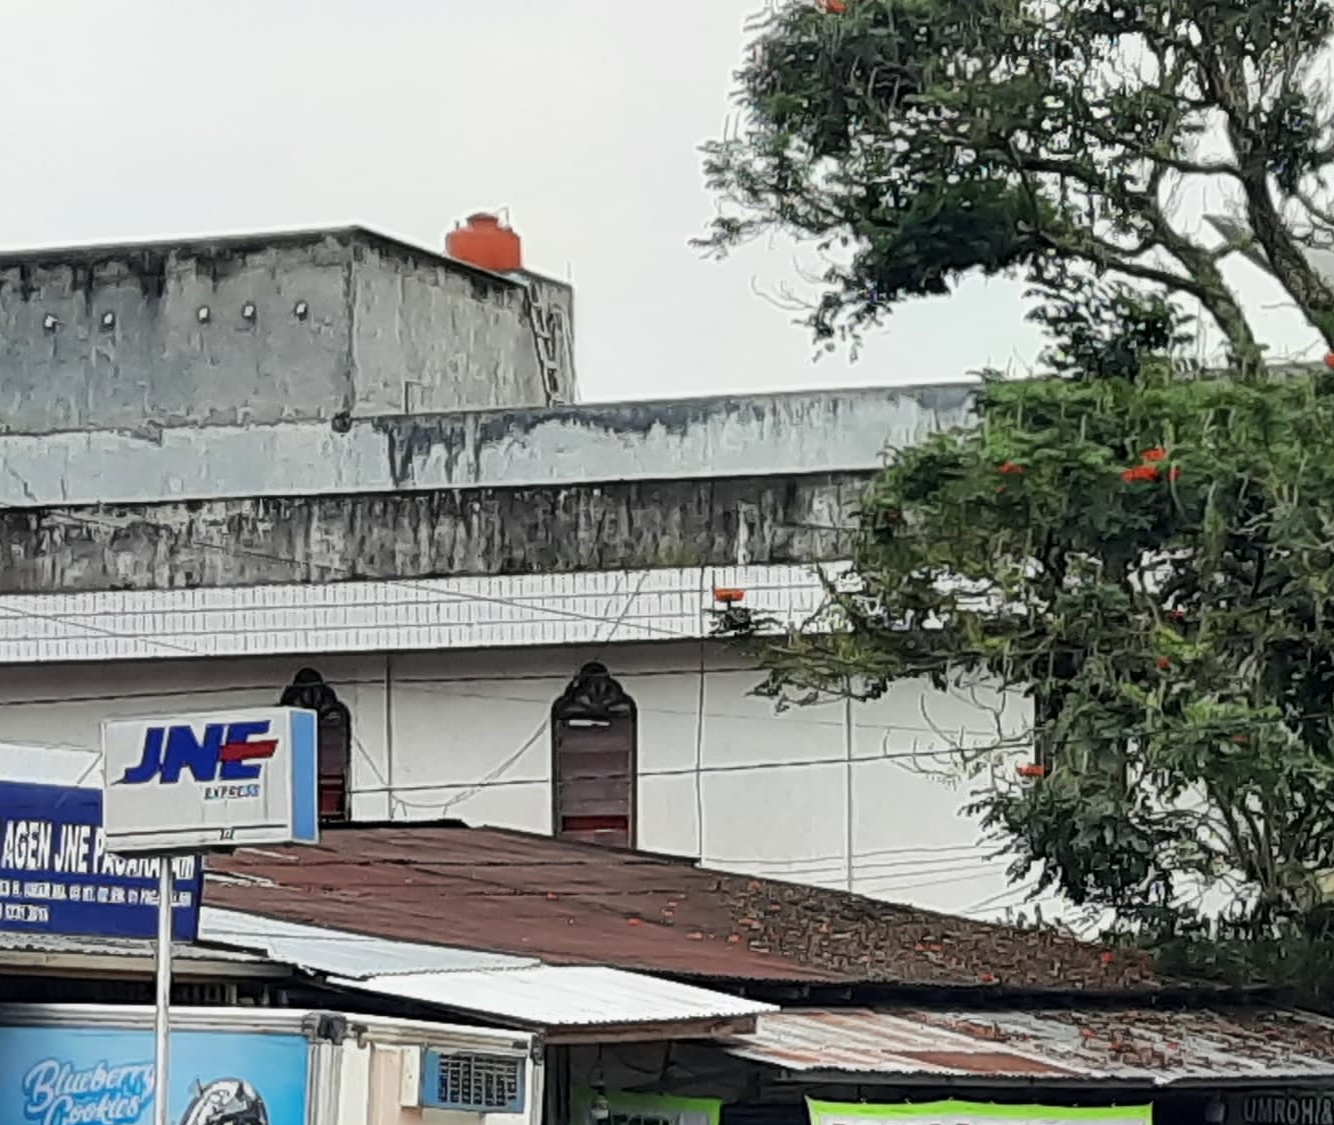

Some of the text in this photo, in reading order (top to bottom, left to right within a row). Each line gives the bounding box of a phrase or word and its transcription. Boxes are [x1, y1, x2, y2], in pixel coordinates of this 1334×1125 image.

[112, 720, 280, 786] JNE
[0, 820, 53, 873] AGEN
[54, 824, 91, 874] JNE
[24, 1059, 155, 1113] Blueberry
